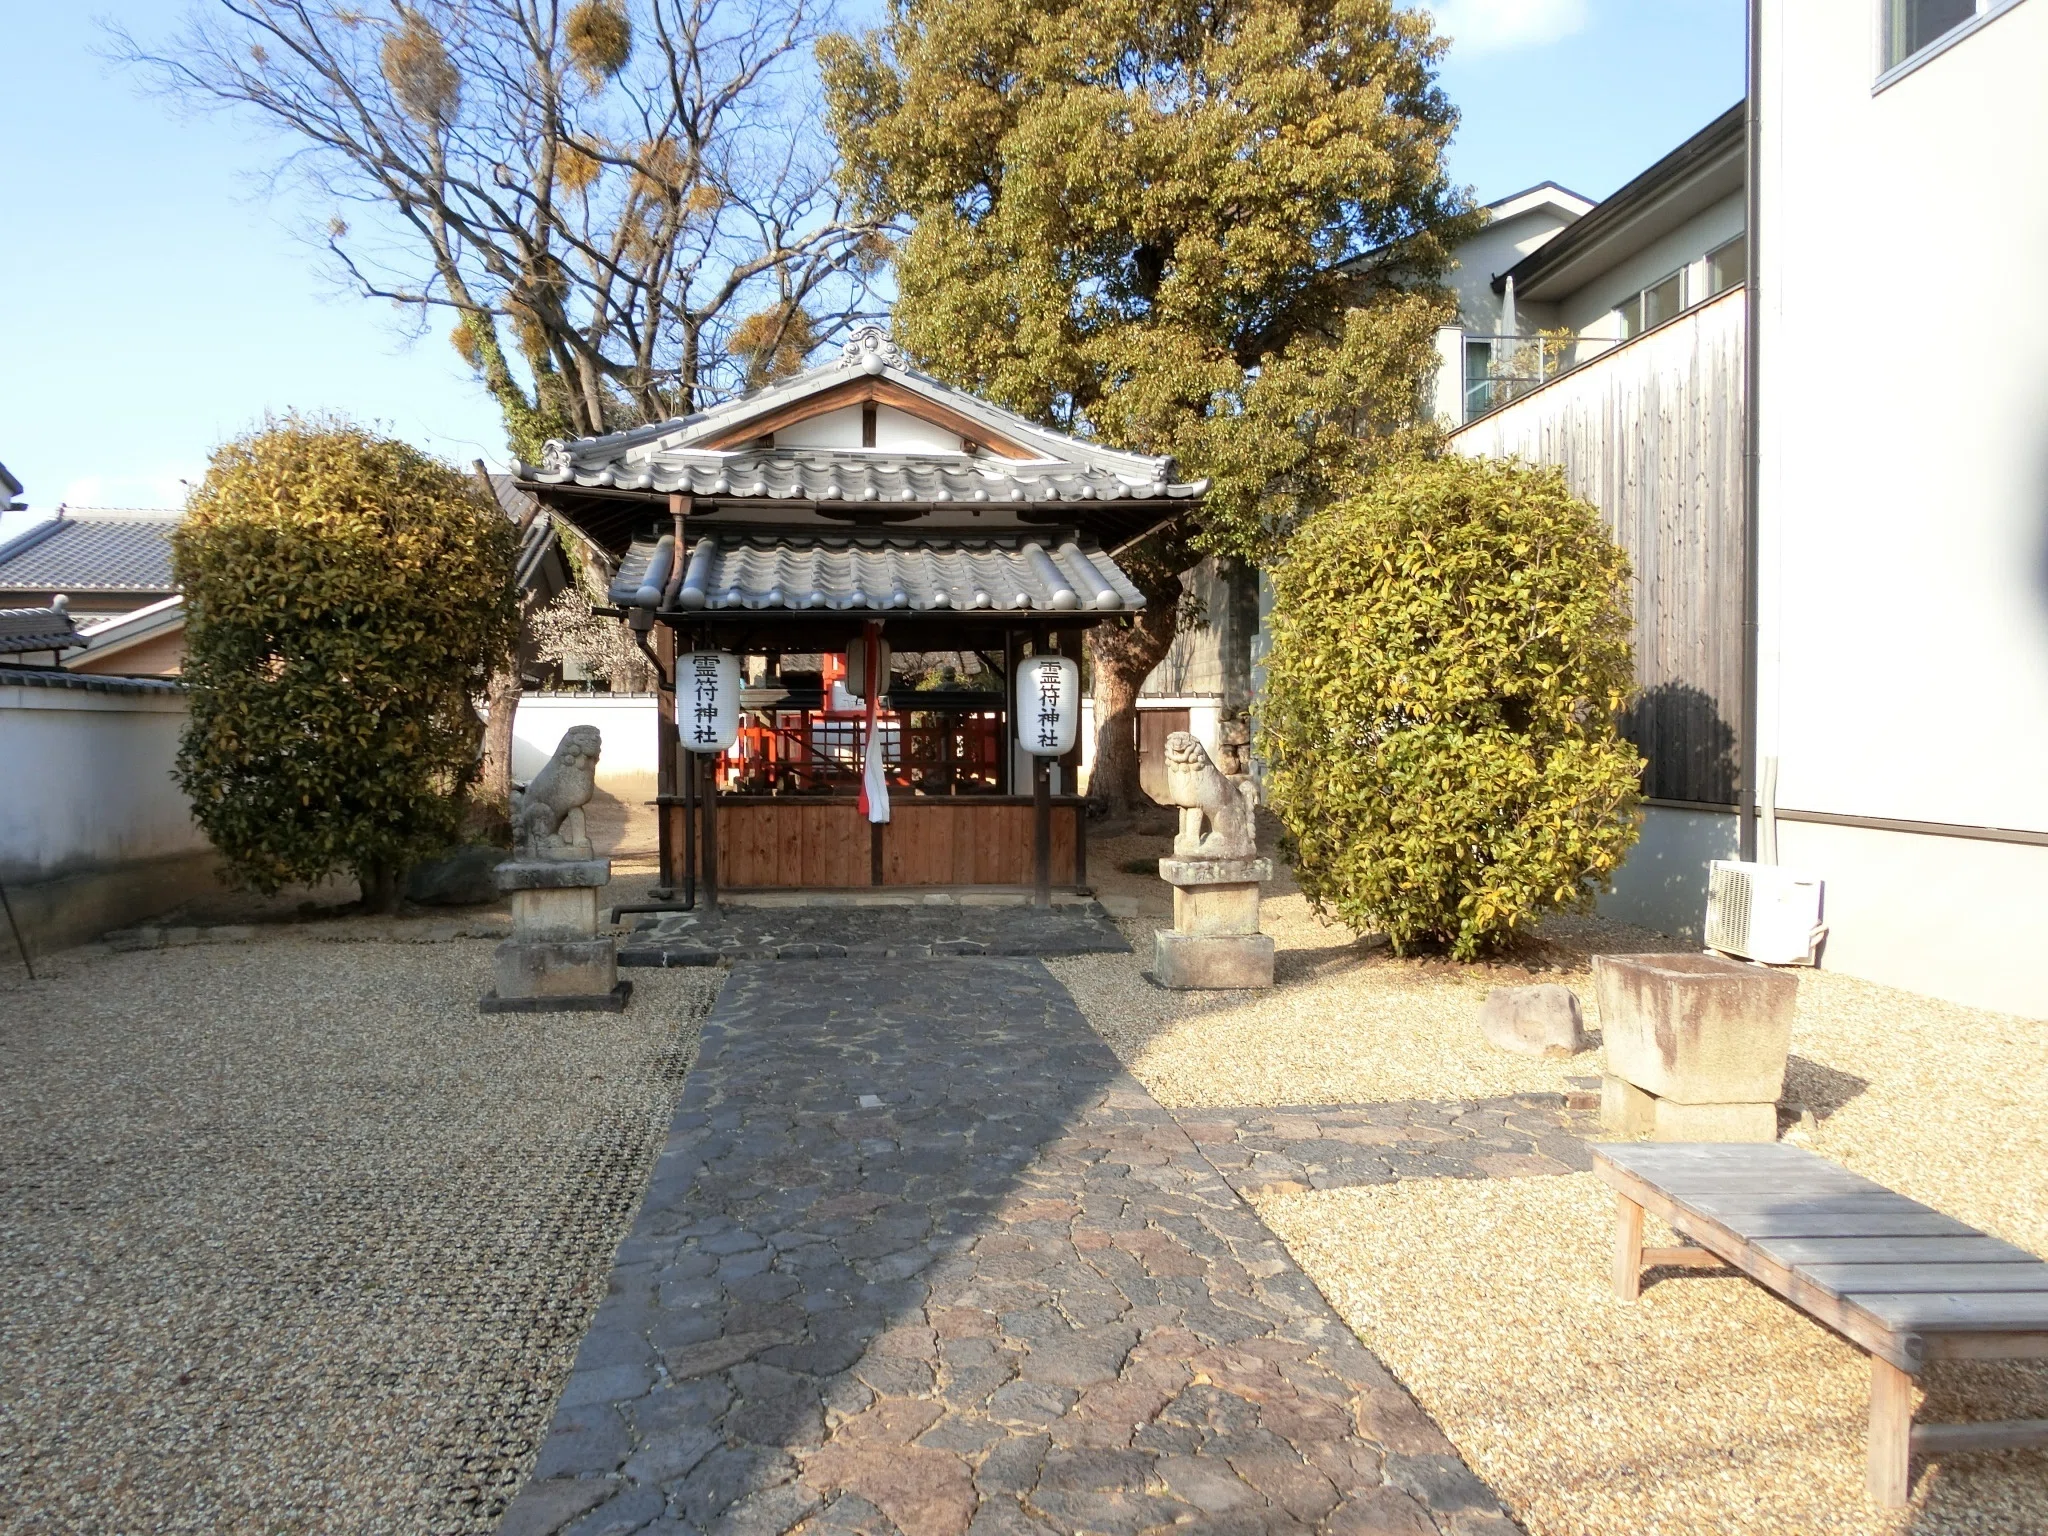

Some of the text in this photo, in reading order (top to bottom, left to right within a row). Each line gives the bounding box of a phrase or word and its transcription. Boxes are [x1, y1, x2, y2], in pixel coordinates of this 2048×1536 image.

[693, 655, 720, 744] 霊符神社
[1037, 661, 1062, 748] 霊符神社
